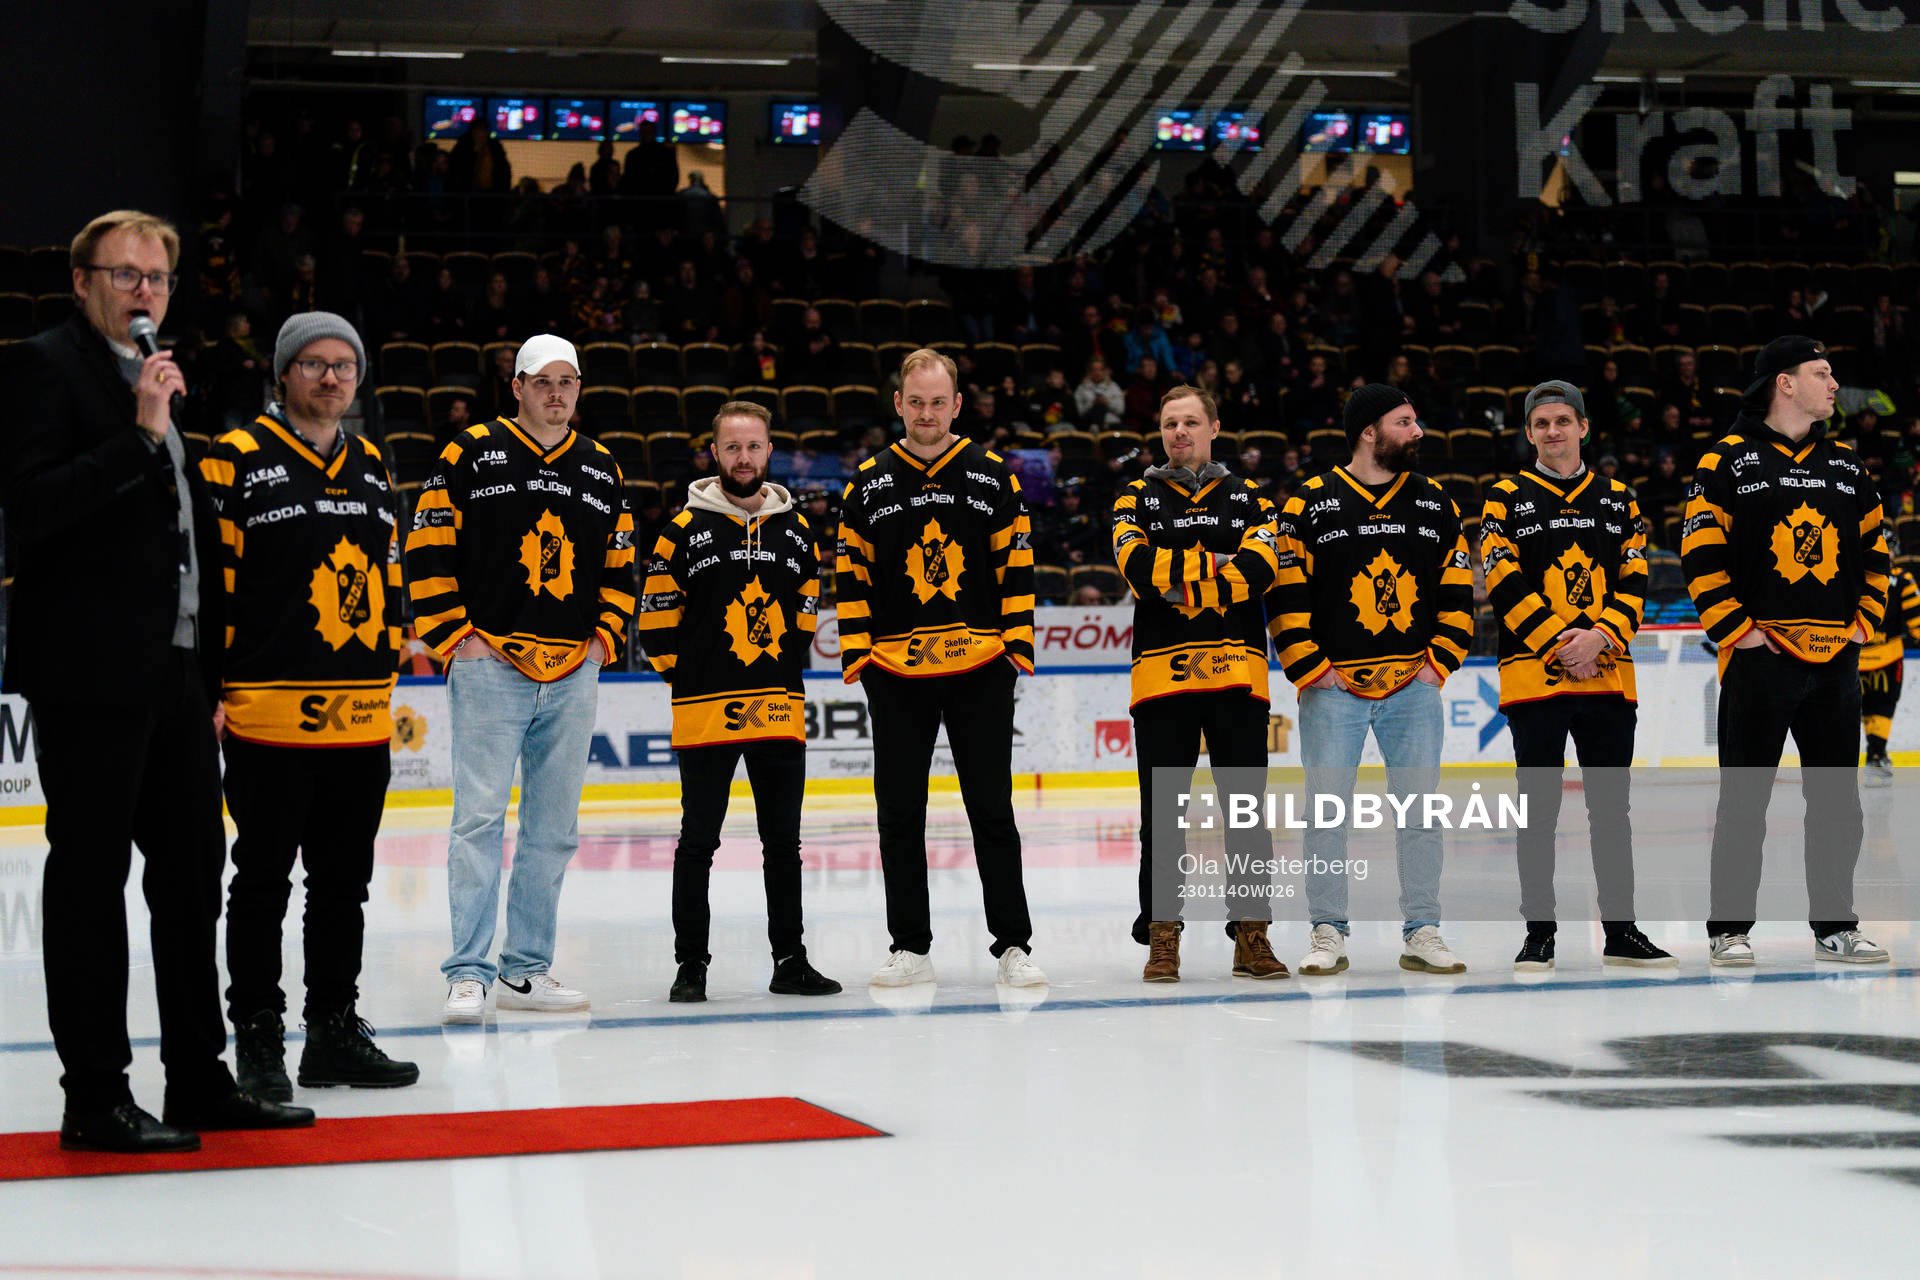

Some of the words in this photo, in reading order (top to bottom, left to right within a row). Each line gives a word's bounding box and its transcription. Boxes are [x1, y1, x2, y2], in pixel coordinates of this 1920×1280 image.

[1514, 74, 1857, 207] Kraft
[530, 479, 571, 496] BOLIDEN
[867, 473, 894, 490] LEAB
[1783, 477, 1826, 488] BOLIDEN
[582, 493, 611, 514] skebo
[1315, 498, 1340, 512] LEAB
[1361, 523, 1406, 535] BOLIDEN
[1552, 517, 1595, 529] BOLIDEN
[1515, 523, 1543, 538] ODA
[945, 647, 967, 659] Kraft
[1809, 644, 1831, 653] Kraft
[351, 714, 373, 725] Kraft
[768, 713, 791, 722] Kraft
